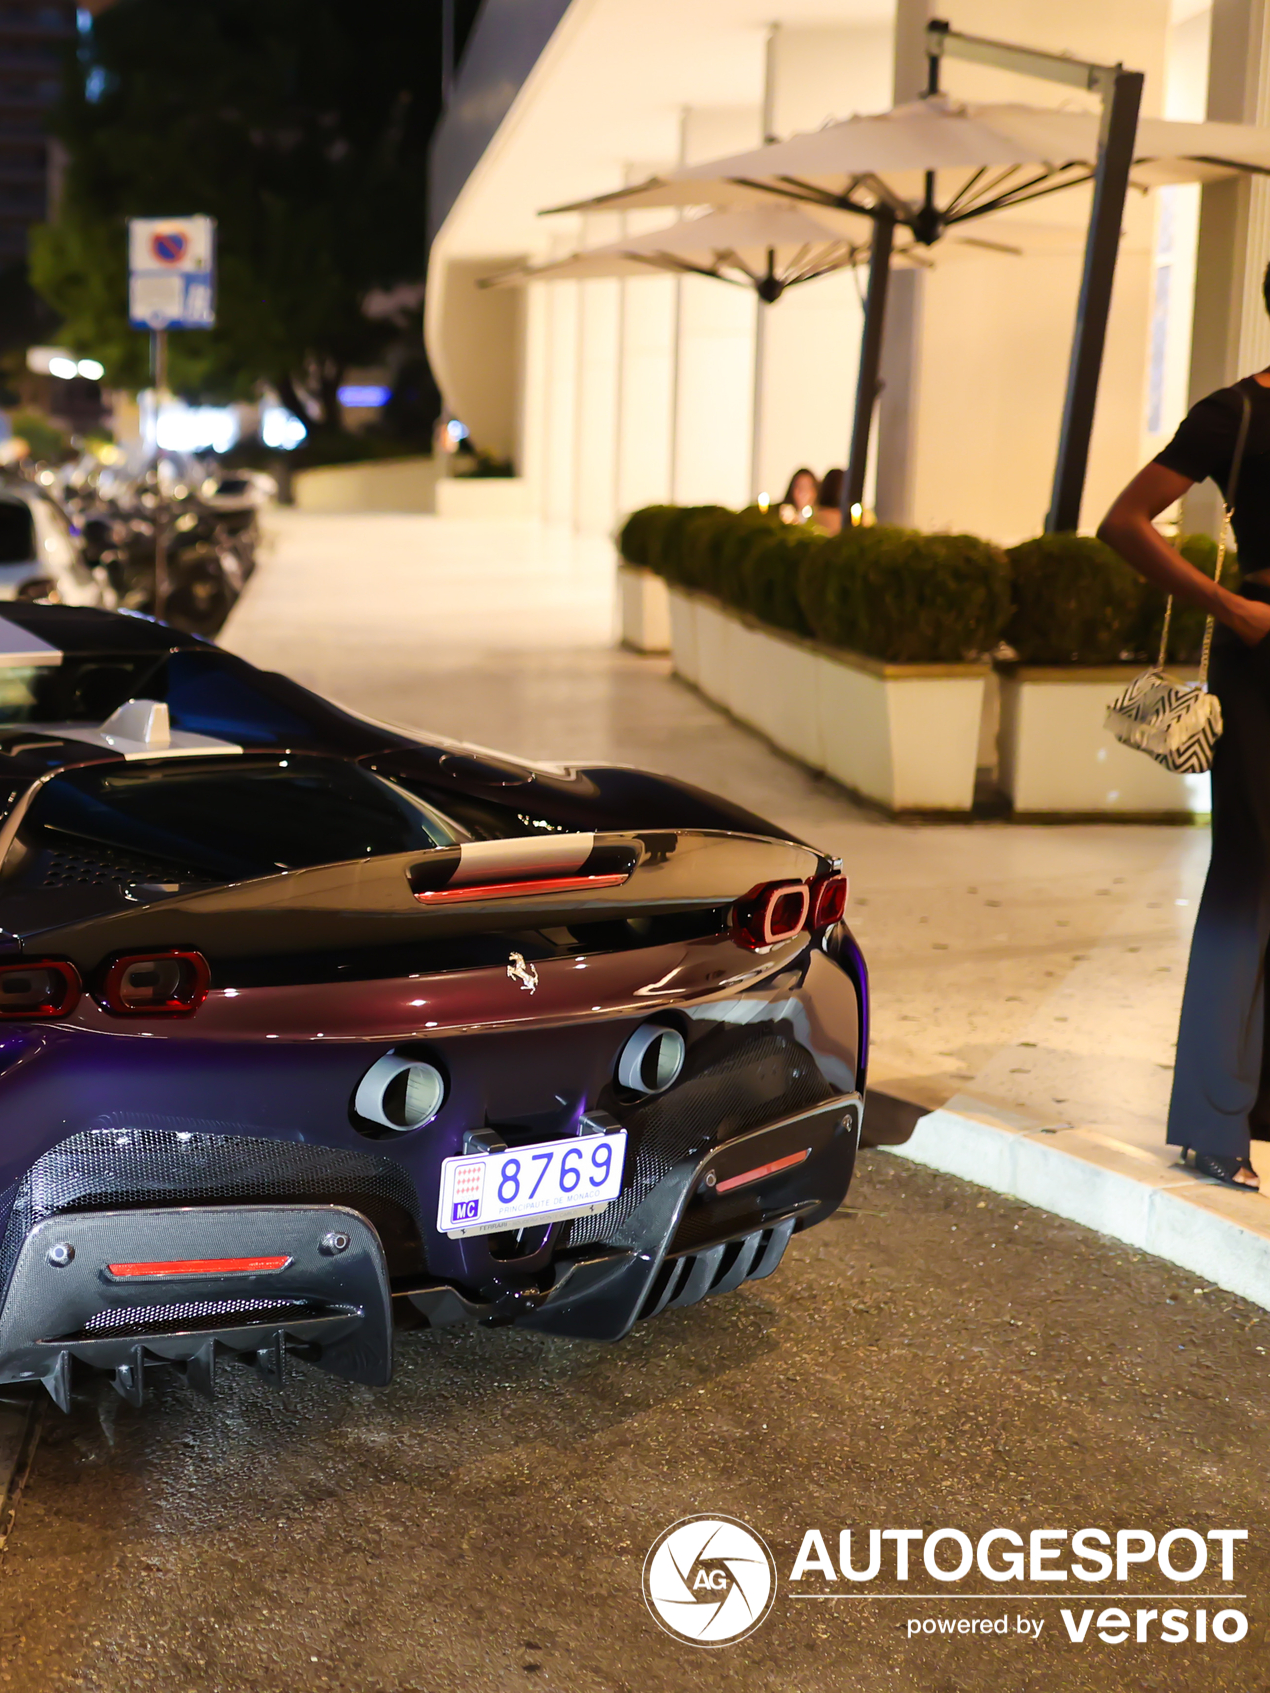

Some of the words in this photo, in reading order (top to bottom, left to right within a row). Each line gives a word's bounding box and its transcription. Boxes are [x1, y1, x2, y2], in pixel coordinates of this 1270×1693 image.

[497, 1142, 613, 1204] 8769
[457, 1201, 475, 1219] MC
[499, 1199, 550, 1214] PRINCIPAUTE
[553, 1196, 563, 1205] DE
[566, 1190, 600, 1203] MONACO
[479, 1222, 508, 1231] FERRARI
